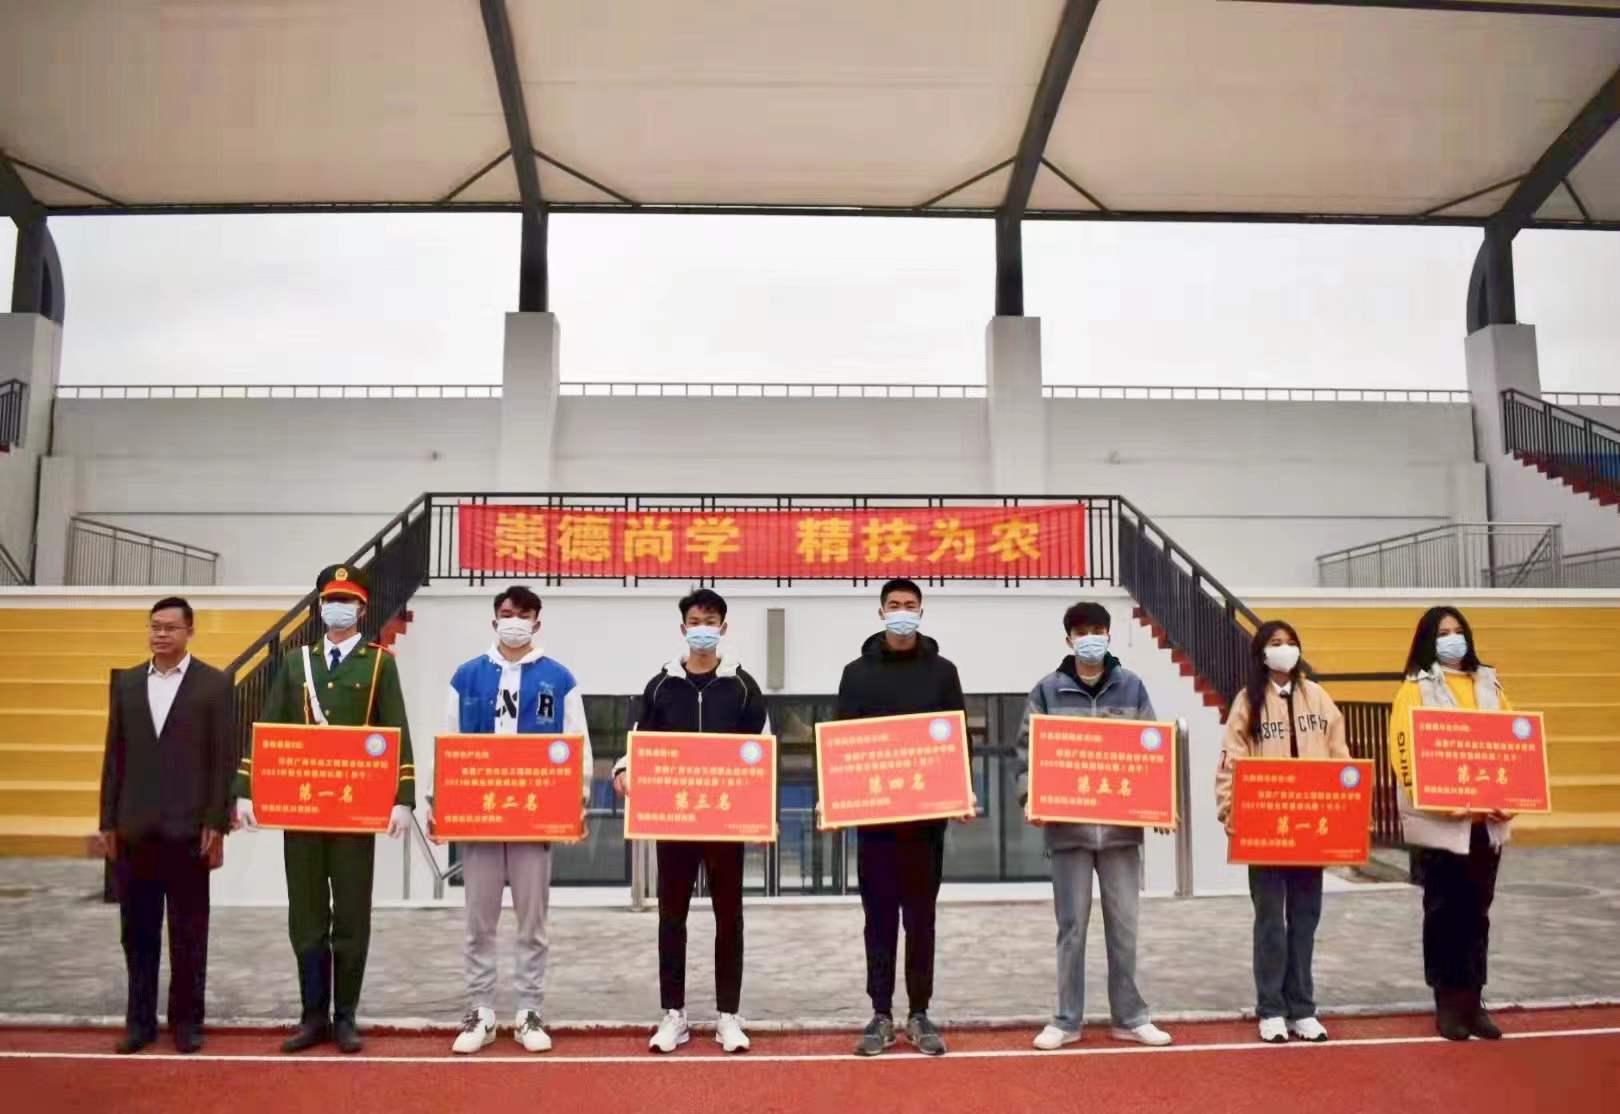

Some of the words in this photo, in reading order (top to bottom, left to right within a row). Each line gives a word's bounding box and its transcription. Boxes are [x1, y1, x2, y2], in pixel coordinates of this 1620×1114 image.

[496, 514, 741, 563] 崇德尚学
[797, 515, 1042, 563] 精技为农
[1457, 764, 1508, 785] 第二名
[298, 782, 353, 804] 第一名
[1077, 775, 1132, 797] 第五名
[482, 791, 538, 812] 第二名
[674, 790, 731, 811] 第三名
[1276, 815, 1329, 836] 第一名
